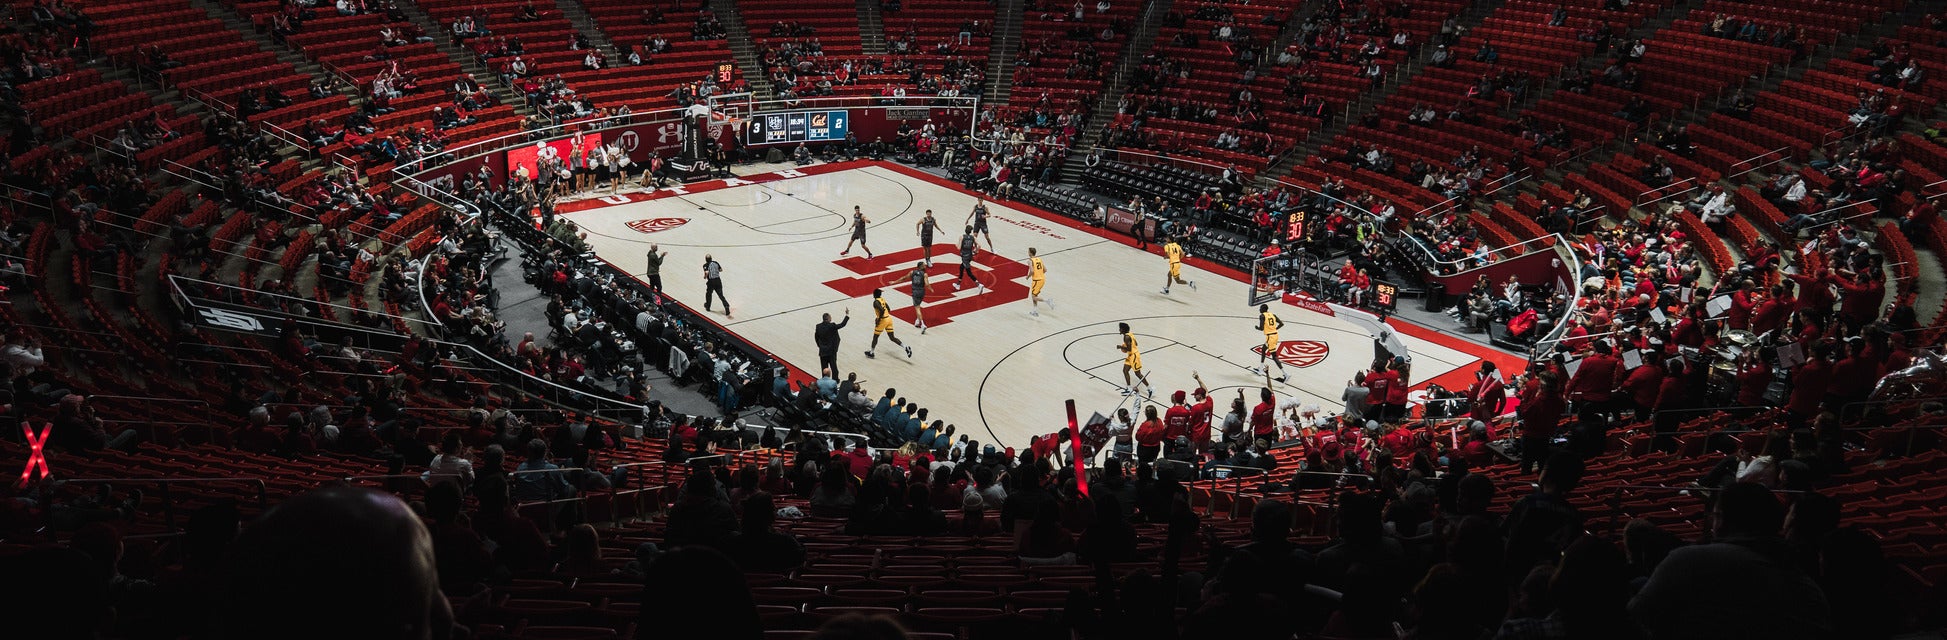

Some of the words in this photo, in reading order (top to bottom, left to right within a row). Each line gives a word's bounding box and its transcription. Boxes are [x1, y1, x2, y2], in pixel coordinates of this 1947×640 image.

[719, 71, 731, 82] 30
[812, 114, 826, 127] Cal
[835, 118, 842, 128] 2
[752, 122, 760, 134] 3
[1289, 211, 1304, 222] 18:33
[1288, 222, 1302, 240] 30
[1377, 284, 1394, 294] 18:33
[1379, 293, 1390, 305] 30
[1268, 317, 1274, 326] 13
[1203, 411, 1210, 422] 5
